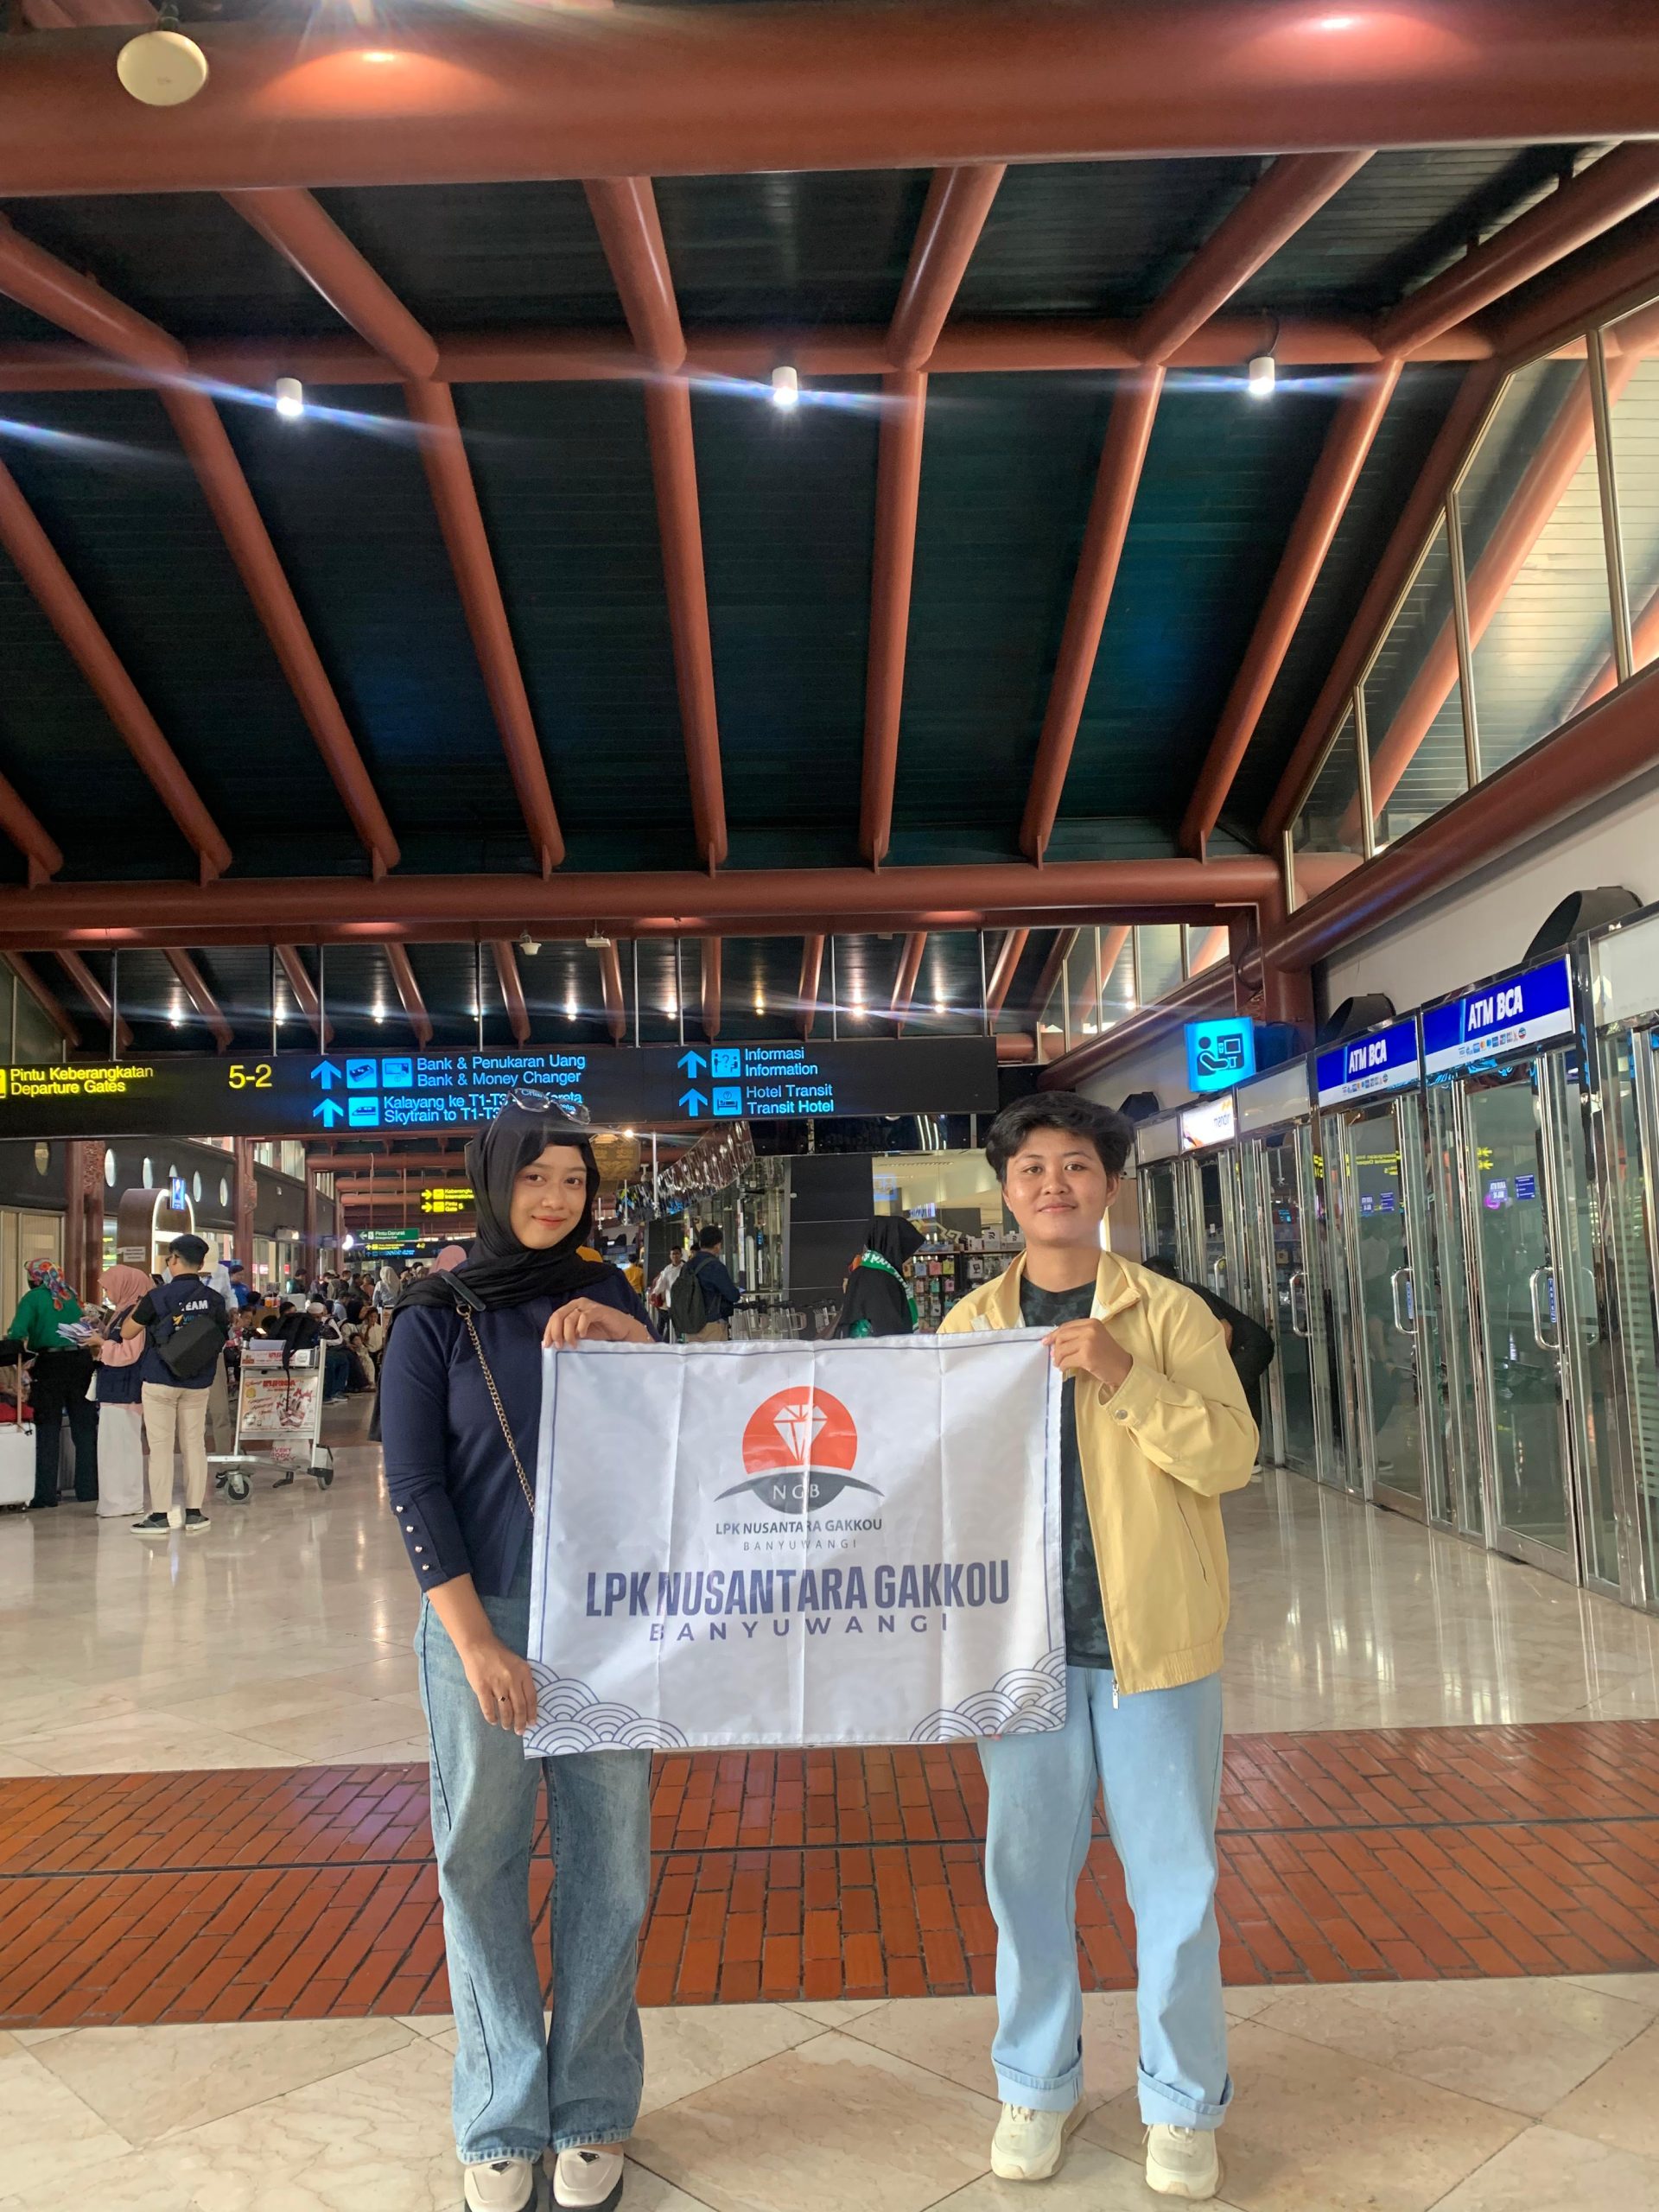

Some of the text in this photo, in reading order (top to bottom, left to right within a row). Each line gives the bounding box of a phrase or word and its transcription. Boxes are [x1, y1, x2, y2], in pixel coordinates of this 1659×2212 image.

[1467, 985, 1524, 1032] ATM BCA
[416, 1053, 586, 1071] Bank & Penukaran Uang
[744, 1046, 804, 1061] Informasi
[1348, 1039, 1388, 1074] ATM BCA
[10, 1065, 154, 1081] Pintu Keberangkatan
[228, 1064, 273, 1089] 5-2
[745, 1062, 818, 1077] Information
[10, 1079, 126, 1097] Departure Gates
[417, 1071, 582, 1088] Bank & Money Changer
[746, 1083, 833, 1098] Hotel Transit
[384, 1095, 444, 1111] Kalayang
[448, 1094, 465, 1107] ke
[468, 1092, 508, 1107] T1-T3
[747, 1099, 835, 1115] Transit Hotel
[385, 1107, 501, 1126] Skytrain to T1-T3
[772, 1483, 820, 1501] NGB
[715, 1518, 883, 1535] LPK NUSANTARA GAKKOU
[743, 1538, 856, 1551] BANYUWANGI
[586, 1559, 1010, 1617] LPK NUSANTARA GAKKOU
[649, 1611, 948, 1642] BANYUWANGI
